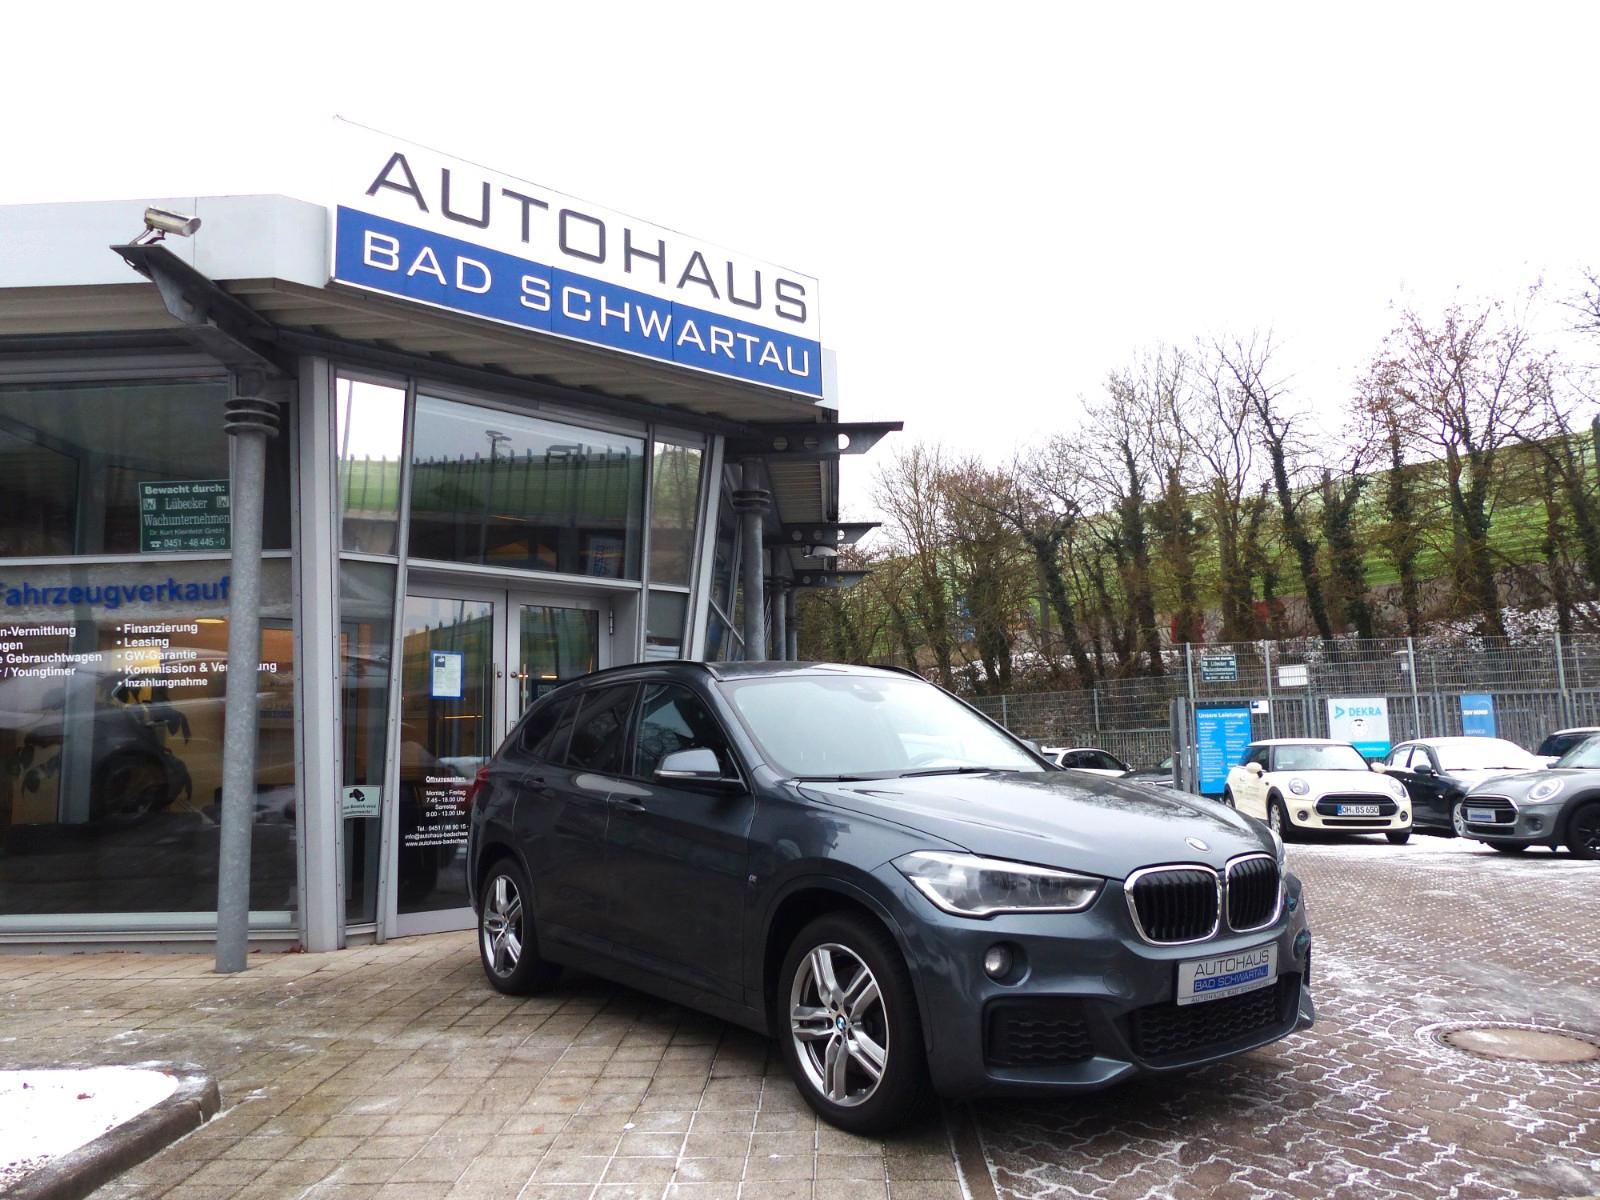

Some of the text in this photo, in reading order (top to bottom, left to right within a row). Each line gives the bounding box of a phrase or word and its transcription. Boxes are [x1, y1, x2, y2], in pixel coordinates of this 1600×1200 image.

[365, 151, 806, 323] AUTOHAUS
[363, 229, 809, 377] BAD SCHWARTAU
[145, 484, 225, 495] Bewacht durch:
[165, 497, 208, 510] Lübecker
[144, 513, 231, 526] Wachunternehmen
[124, 623, 198, 635] Finanzierung
[0, 642, 23, 652] gen
[125, 637, 169, 648] Leasing
[6, 652, 102, 664] Gebrauchtwagen
[125, 649, 197, 660] GW-Garantie
[11, 667, 76, 679] Youngtimer
[125, 663, 196, 674] Kommission
[199, 662, 208, 671] &
[125, 677, 208, 688] Inzahlungnahme
[1349, 706, 1382, 717] DEKRA
[1194, 950, 1269, 977] AUTOHAUS
[1194, 966, 1268, 991] BAD SCHWARTAU
